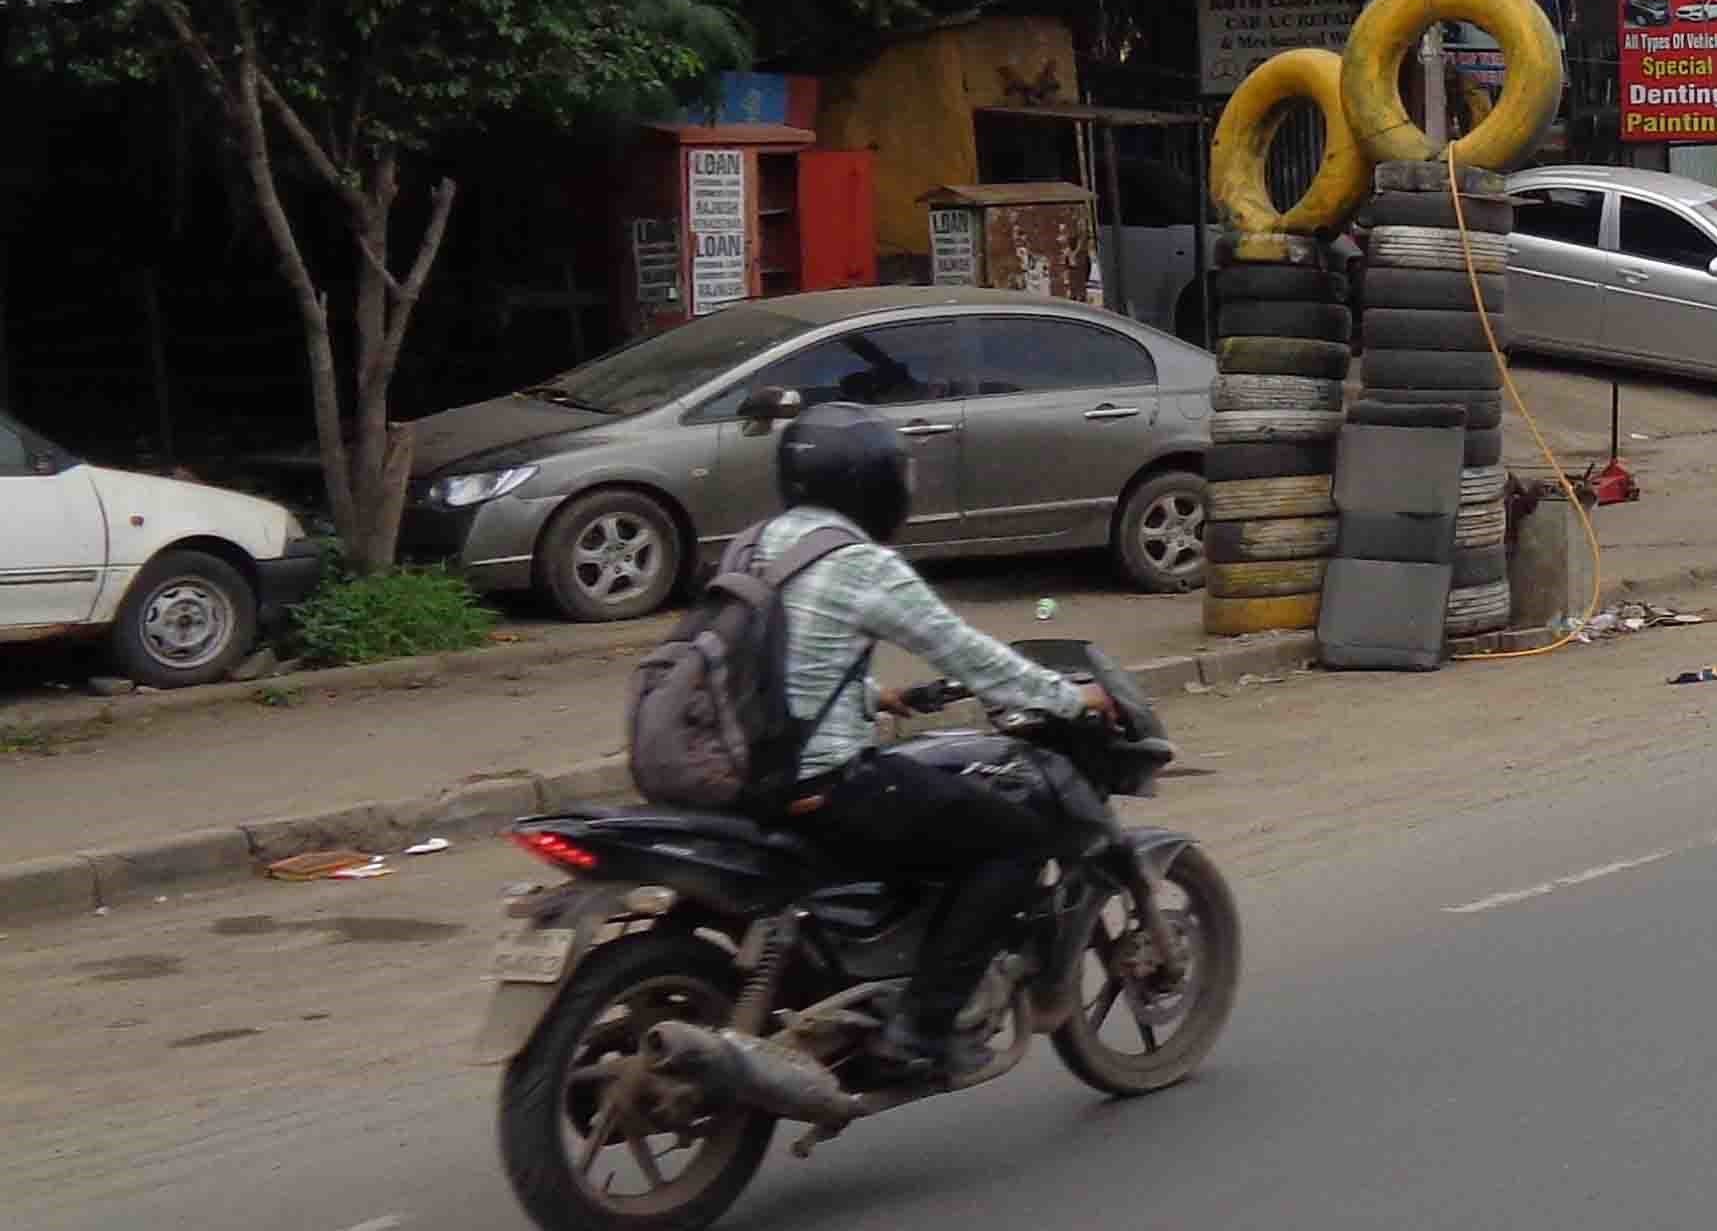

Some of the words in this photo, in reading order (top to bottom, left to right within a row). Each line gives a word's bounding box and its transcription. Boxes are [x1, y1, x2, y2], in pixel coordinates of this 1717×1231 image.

[1625, 33, 1640, 50] All
[1641, 33, 1671, 54] Types
[1672, 33, 1685, 50] Of
[1642, 56, 1714, 80] Special
[695, 153, 740, 176] LOAN
[696, 235, 741, 257] LOAN
